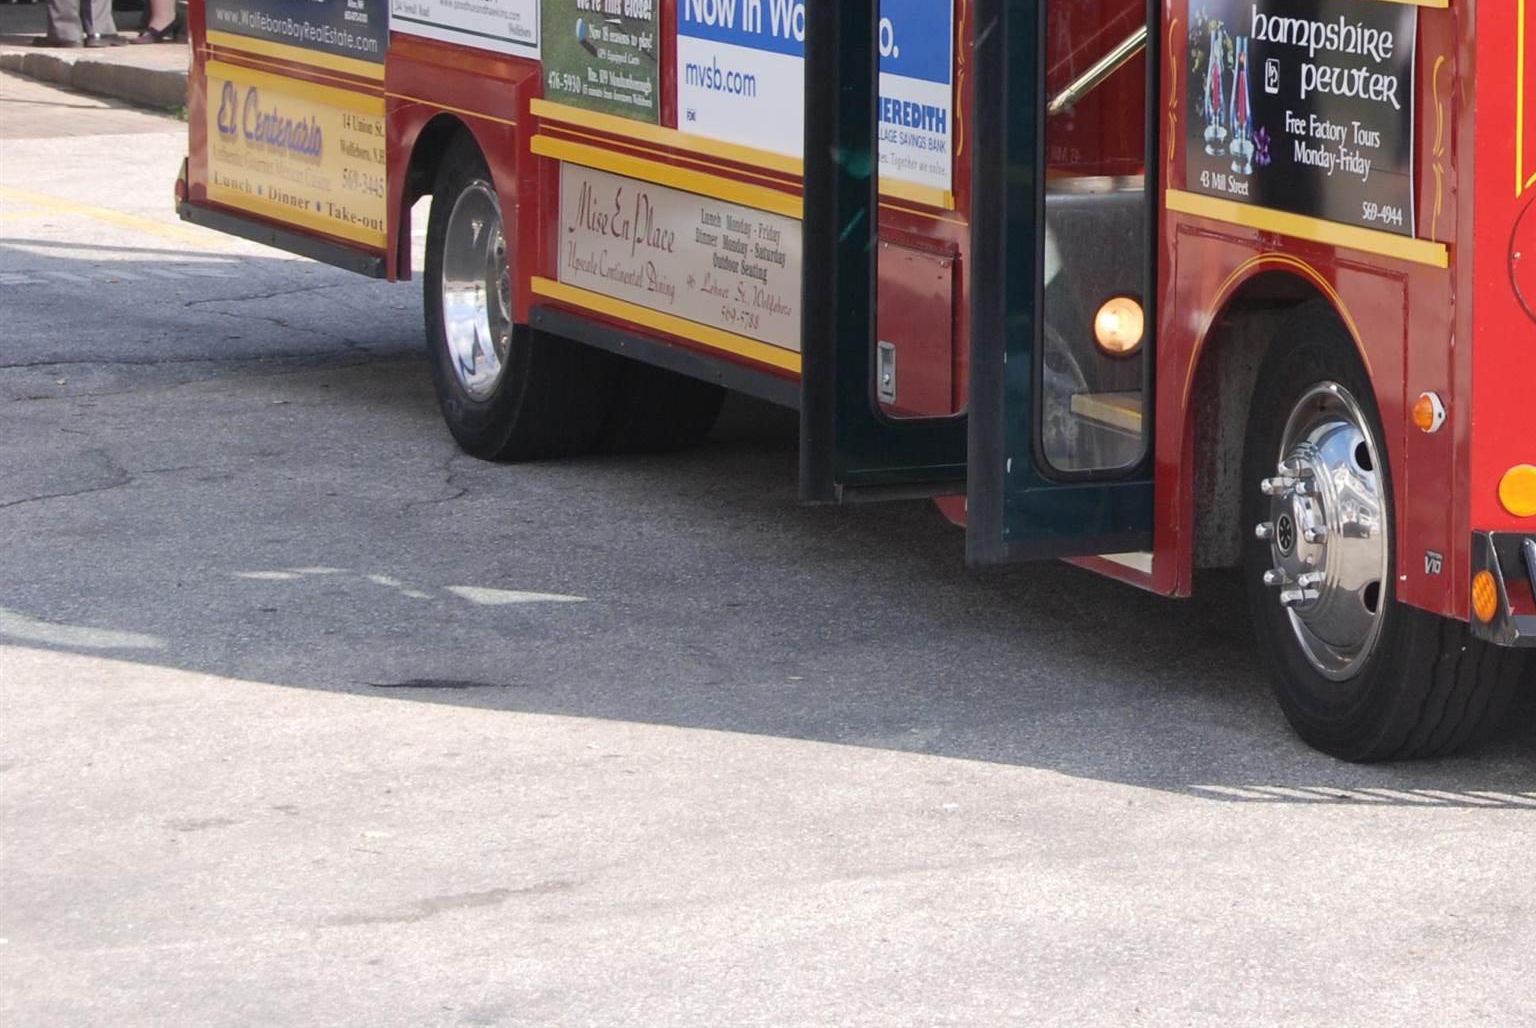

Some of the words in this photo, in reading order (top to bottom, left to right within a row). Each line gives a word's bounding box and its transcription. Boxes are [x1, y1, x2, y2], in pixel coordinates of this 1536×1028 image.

[686, 56, 757, 98] mvsb.com
[217, 80, 239, 136] El
[927, 137, 947, 155] BANK
[1285, 110, 1306, 136] Free
[1309, 114, 1348, 150] Factory
[1351, 121, 1381, 149] Tours
[1293, 139, 1372, 182] Monday-Friday
[214, 170, 253, 195] Lunch
[267, 185, 311, 211] Dinner
[326, 202, 385, 232] Take-out
[1211, 172, 1227, 193] Mill
[1228, 175, 1250, 197] Street
[569, 180, 608, 236] Mise
[611, 186, 630, 241] En
[631, 192, 675, 258] Place
[700, 208, 721, 229] Lunch
[726, 214, 752, 239] Monday
[758, 223, 781, 253] Friday
[1361, 200, 1403, 227] 569-4944
[695, 227, 718, 248] Dinner
[722, 234, 749, 259] Monday
[754, 242, 787, 269] Saturday
[713, 251, 739, 274] Outdoor
[741, 259, 768, 286] Seating
